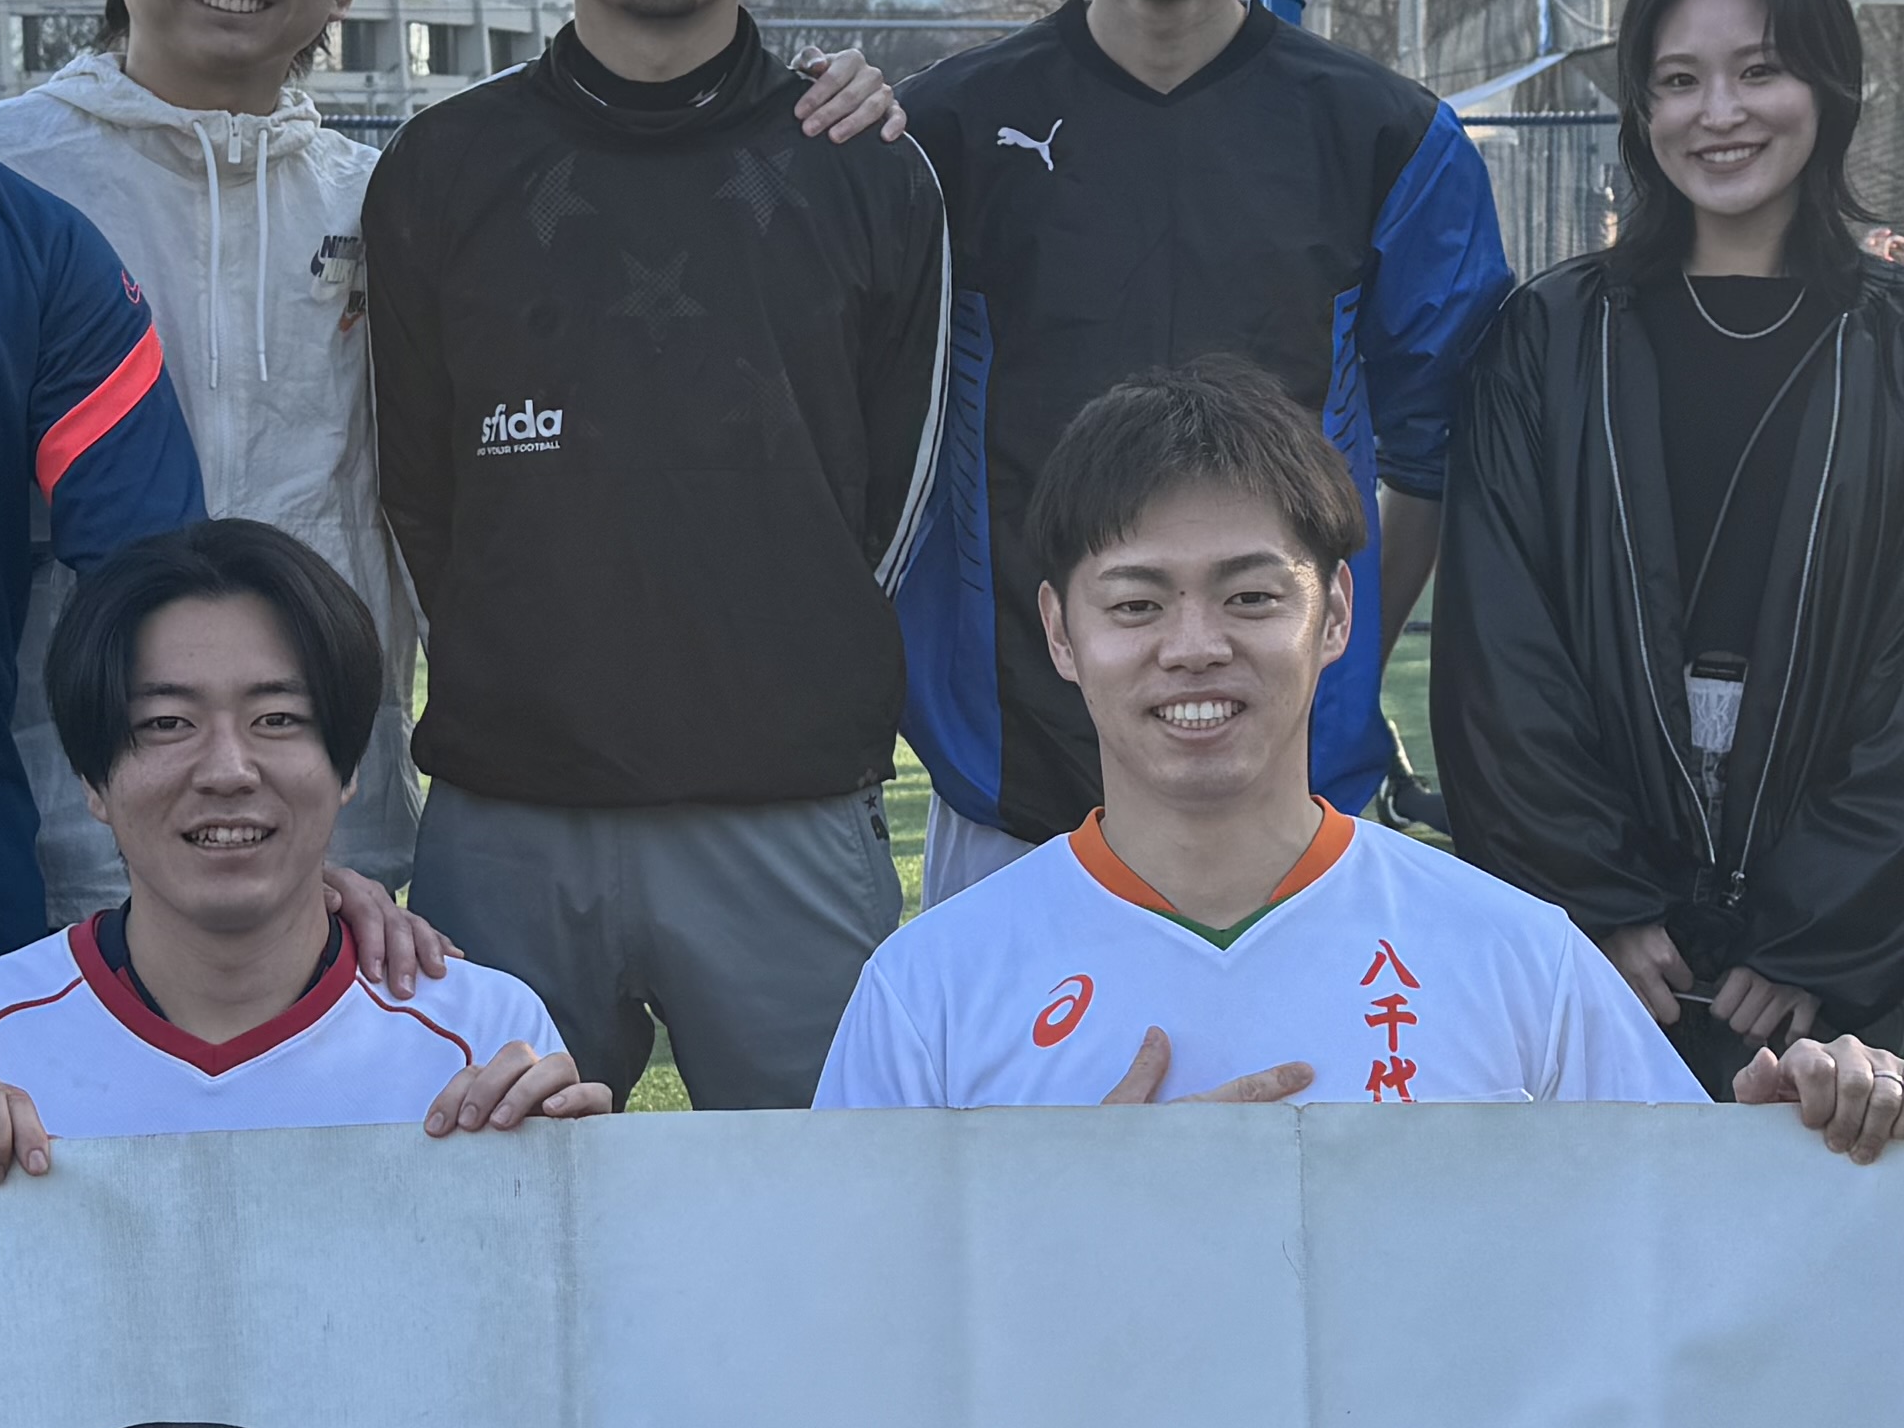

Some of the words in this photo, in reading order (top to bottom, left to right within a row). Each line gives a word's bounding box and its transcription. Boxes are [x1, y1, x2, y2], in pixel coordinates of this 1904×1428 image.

[481, 399, 563, 443] sfida
[514, 441, 560, 453] FOOTBALL
[1359, 938, 1421, 1103] 八千代
